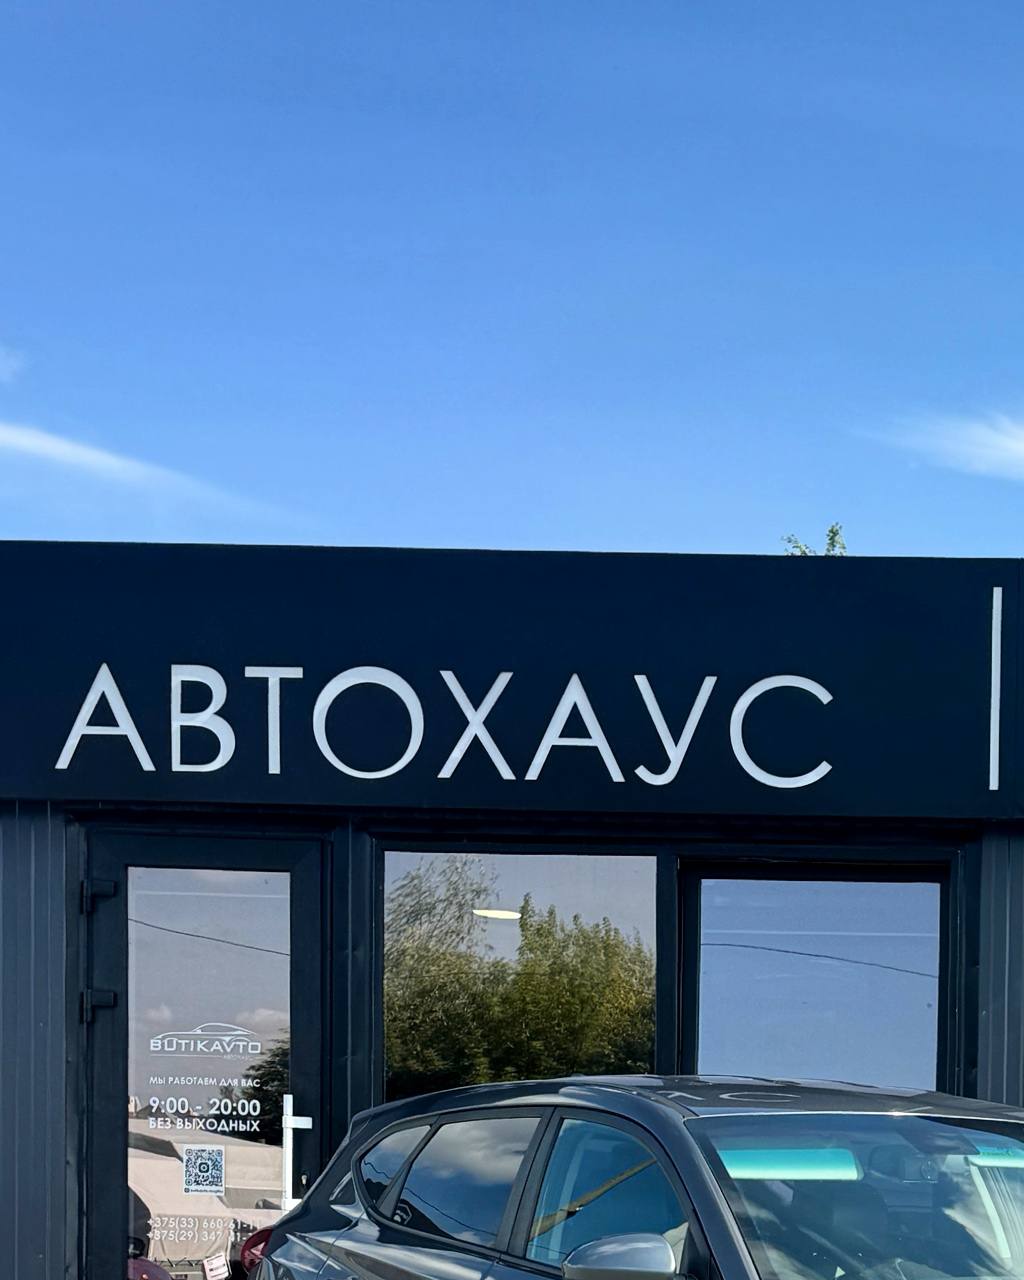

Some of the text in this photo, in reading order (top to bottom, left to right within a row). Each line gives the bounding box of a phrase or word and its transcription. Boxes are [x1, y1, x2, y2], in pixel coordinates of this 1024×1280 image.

[54, 662, 834, 789] АВТОХАУС
[150, 1038, 262, 1054] BUTIKAVTO
[149, 1076, 261, 1087] МЫ РАБОТАЕМ ДЛЯ ВАС
[149, 1097, 189, 1114] 9:00
[208, 1098, 261, 1116] 20:00
[149, 1117, 261, 1132] БЕЗ ВЫХОДНЫХ
[147, 1217, 199, 1232] +375(33)
[146, 1229, 198, 1244] +375(29)
